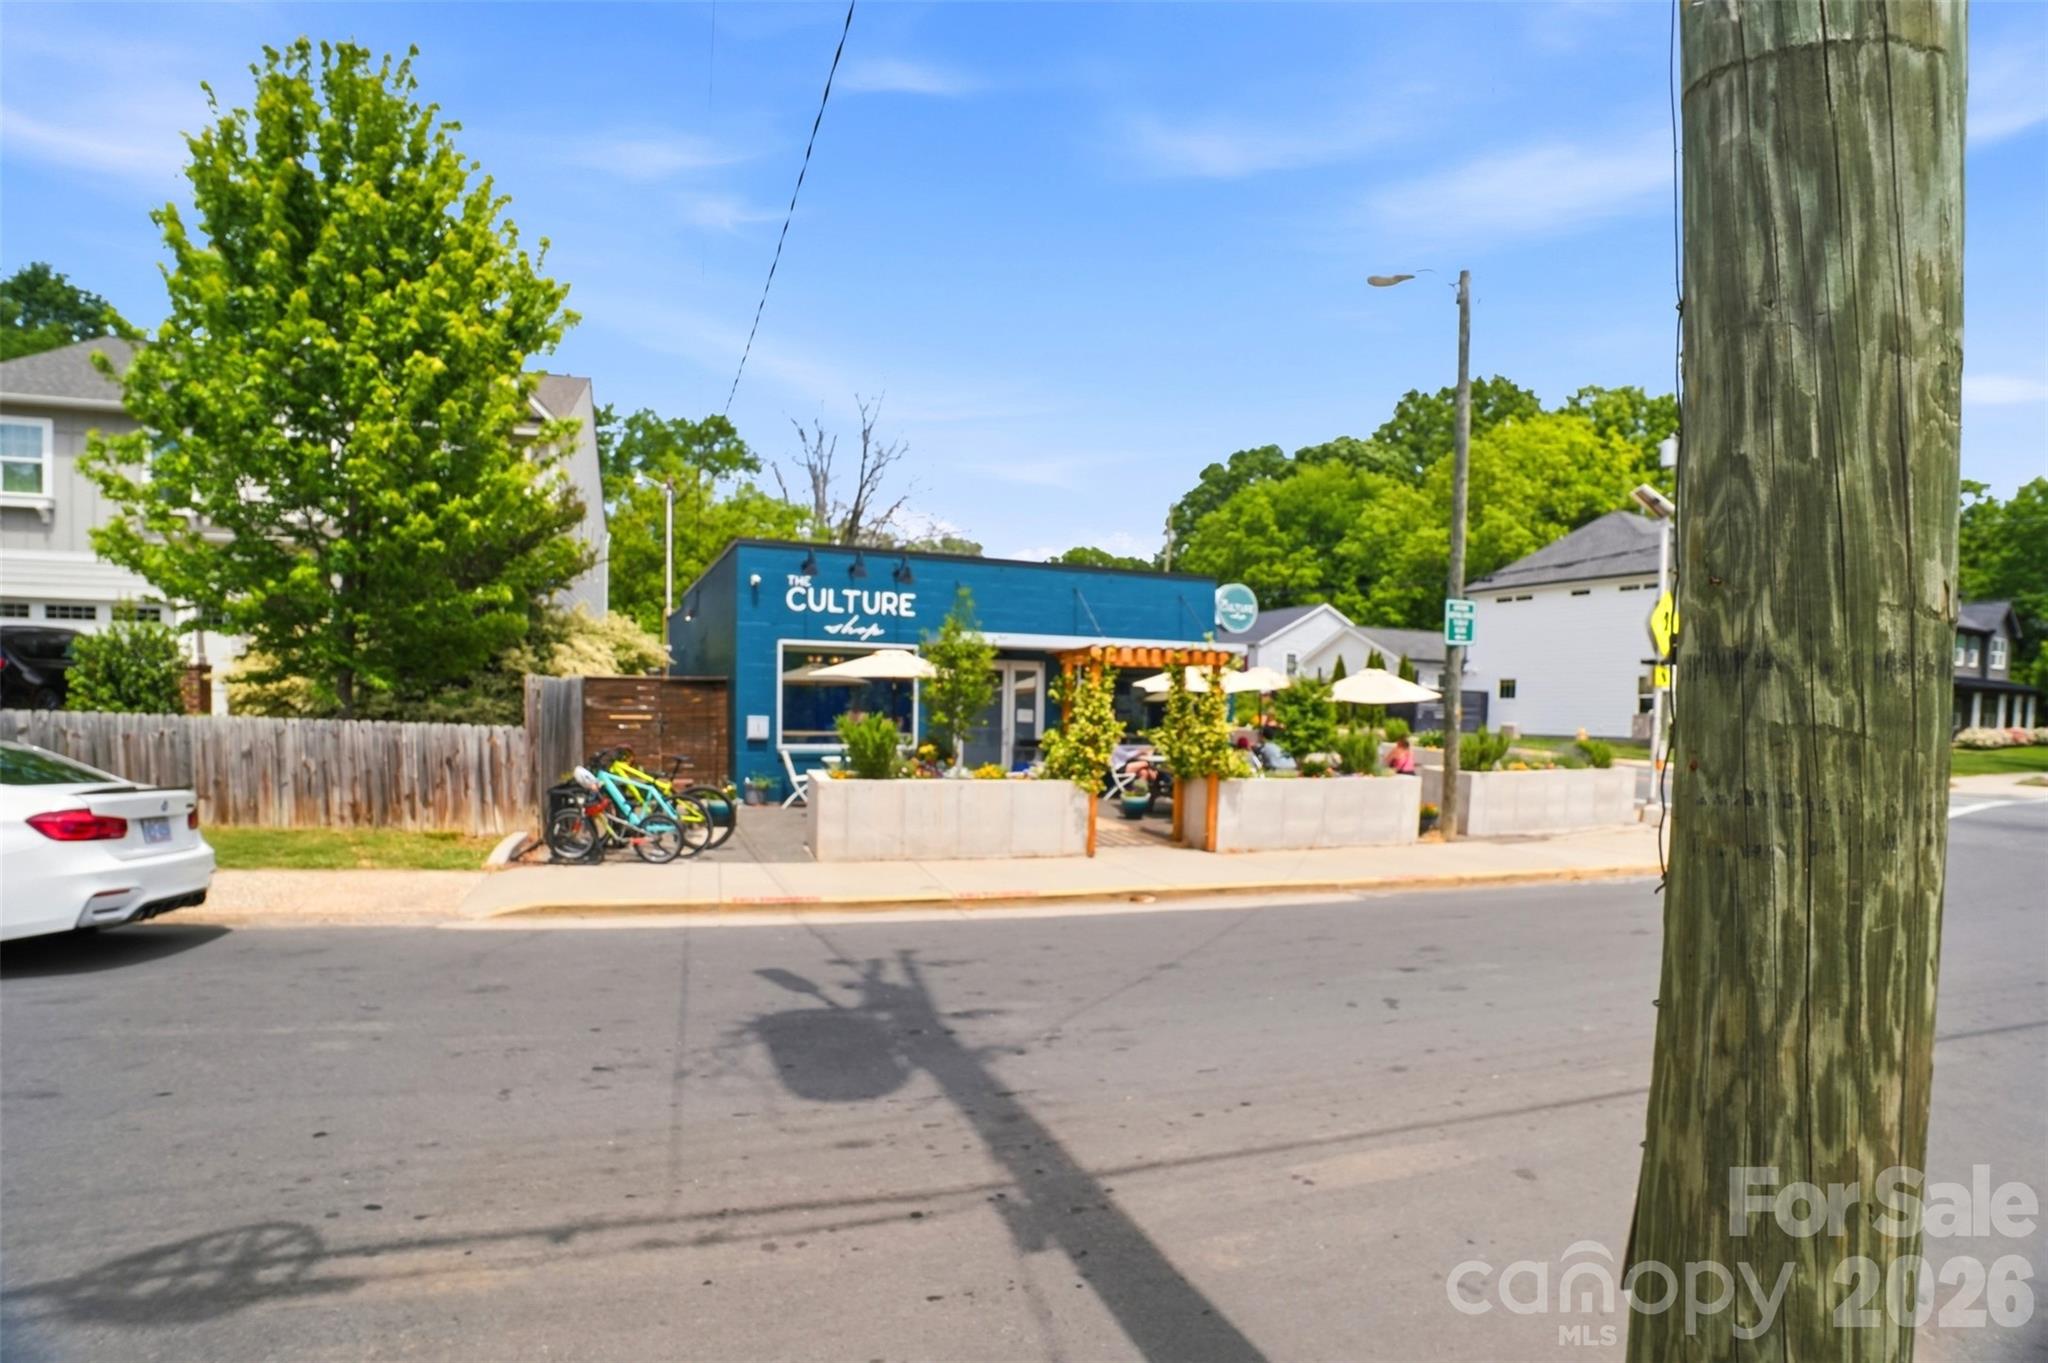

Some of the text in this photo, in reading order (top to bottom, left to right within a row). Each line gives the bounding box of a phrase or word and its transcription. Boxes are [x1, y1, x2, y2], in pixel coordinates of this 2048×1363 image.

[786, 574, 812, 587] THE
[785, 586, 917, 617] CULTURE
[823, 614, 886, 641] shop
